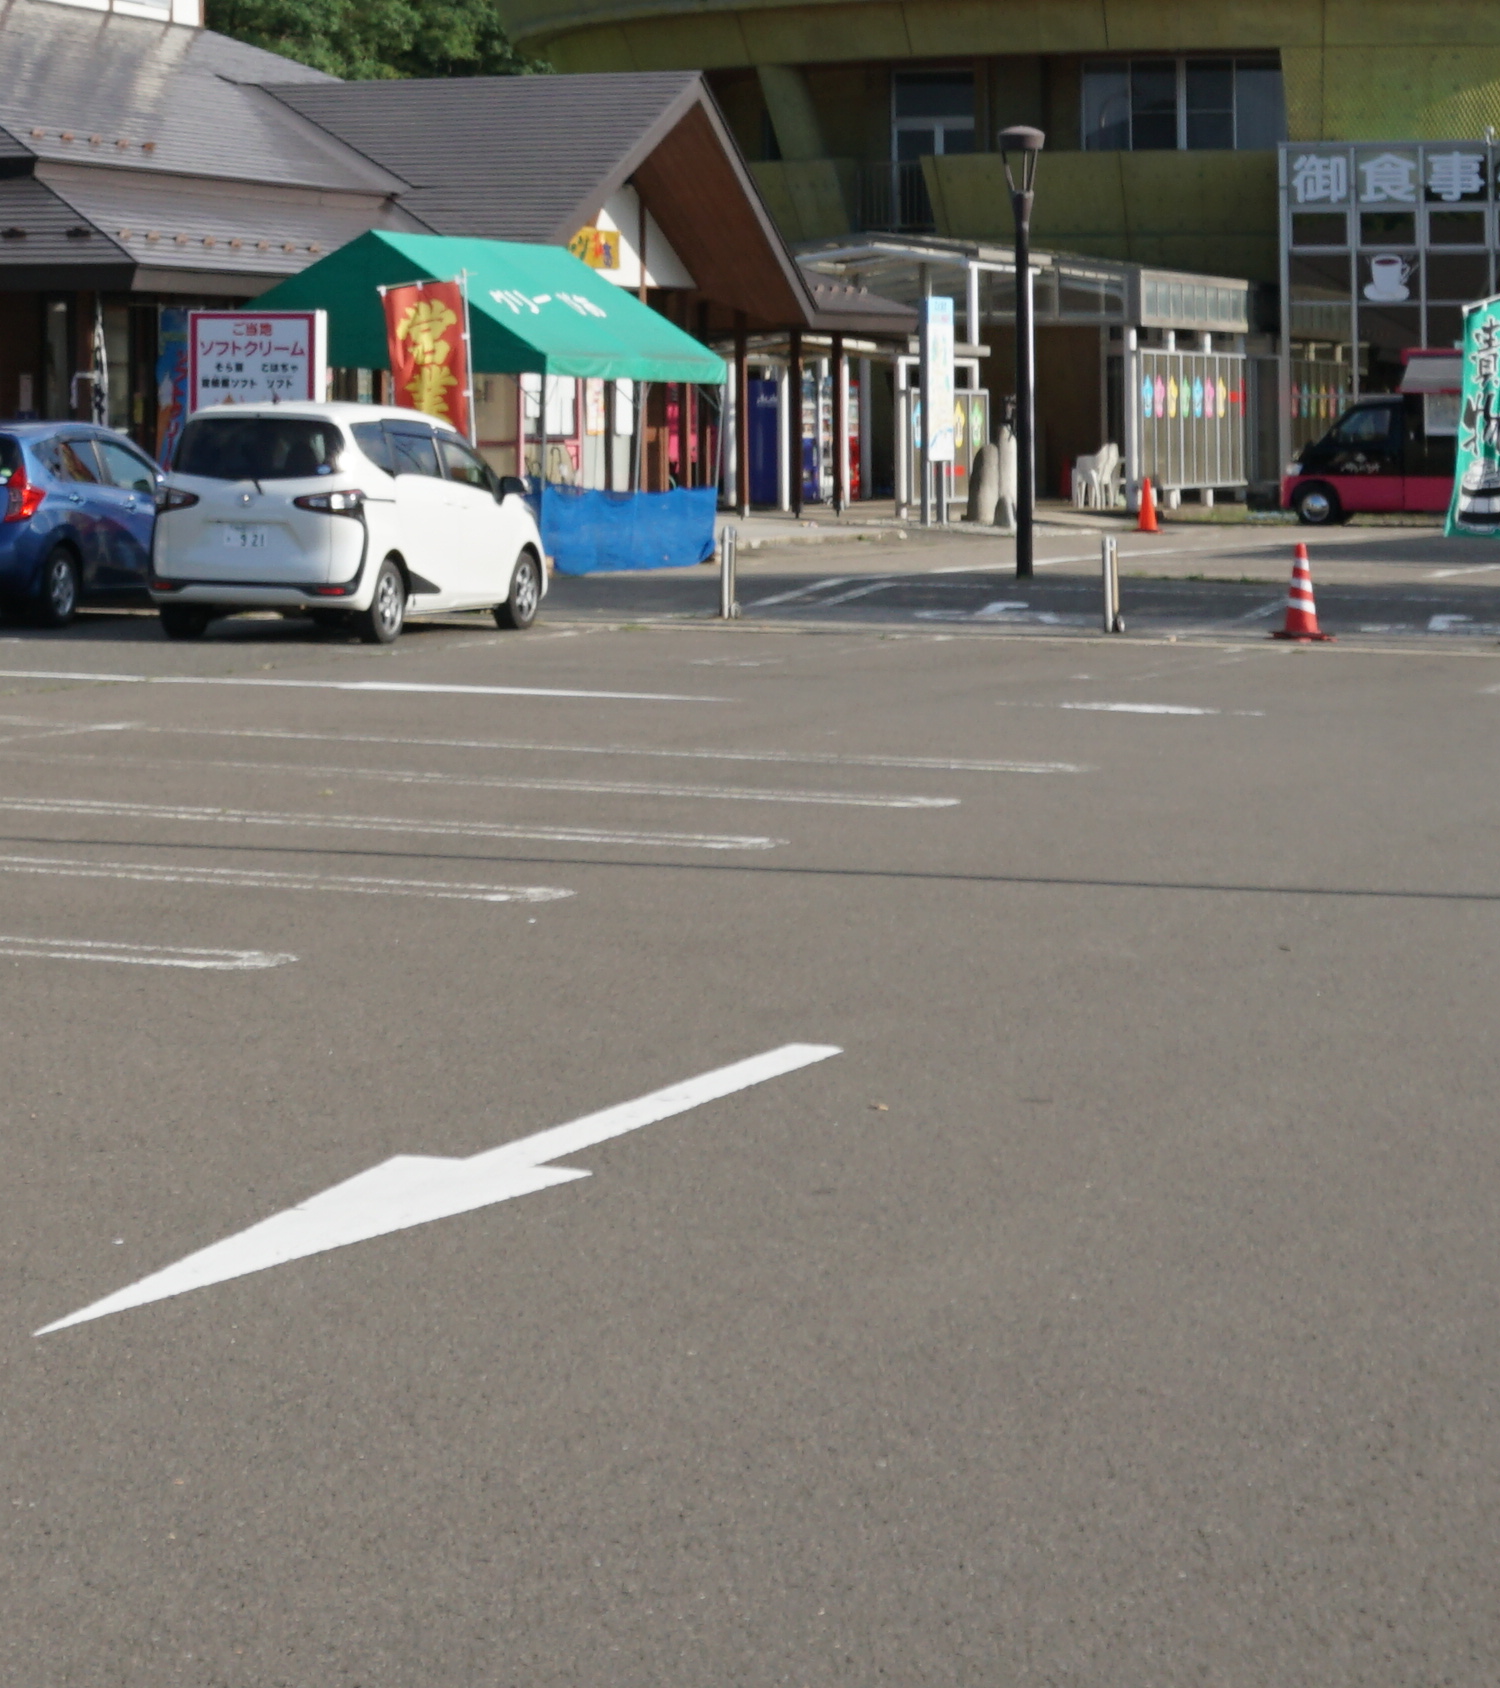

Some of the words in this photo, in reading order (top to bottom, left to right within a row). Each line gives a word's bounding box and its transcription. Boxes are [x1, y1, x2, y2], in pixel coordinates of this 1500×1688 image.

[200, 340, 305, 357] ソフトクリーム
[397, 299, 459, 423] 営業
